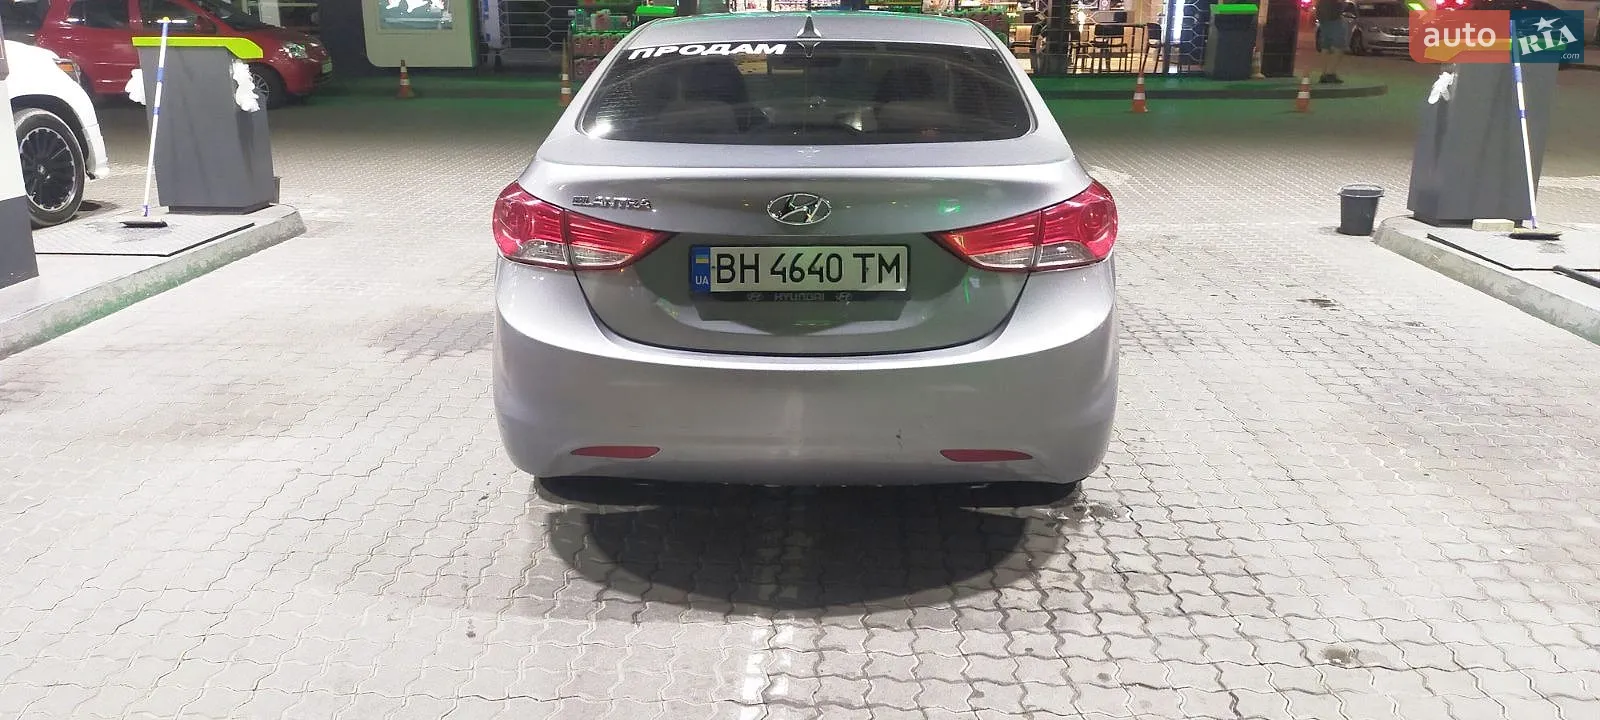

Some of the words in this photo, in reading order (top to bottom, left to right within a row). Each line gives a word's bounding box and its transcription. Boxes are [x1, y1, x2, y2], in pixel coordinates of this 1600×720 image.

[628, 43, 787, 60] ПРОДАМ
[572, 195, 653, 210] ELANTRA
[716, 253, 760, 284] BH
[770, 252, 842, 283] 4640
[852, 253, 900, 283] TM
[695, 275, 709, 285] UA
[774, 292, 825, 301] HYUNDAI
